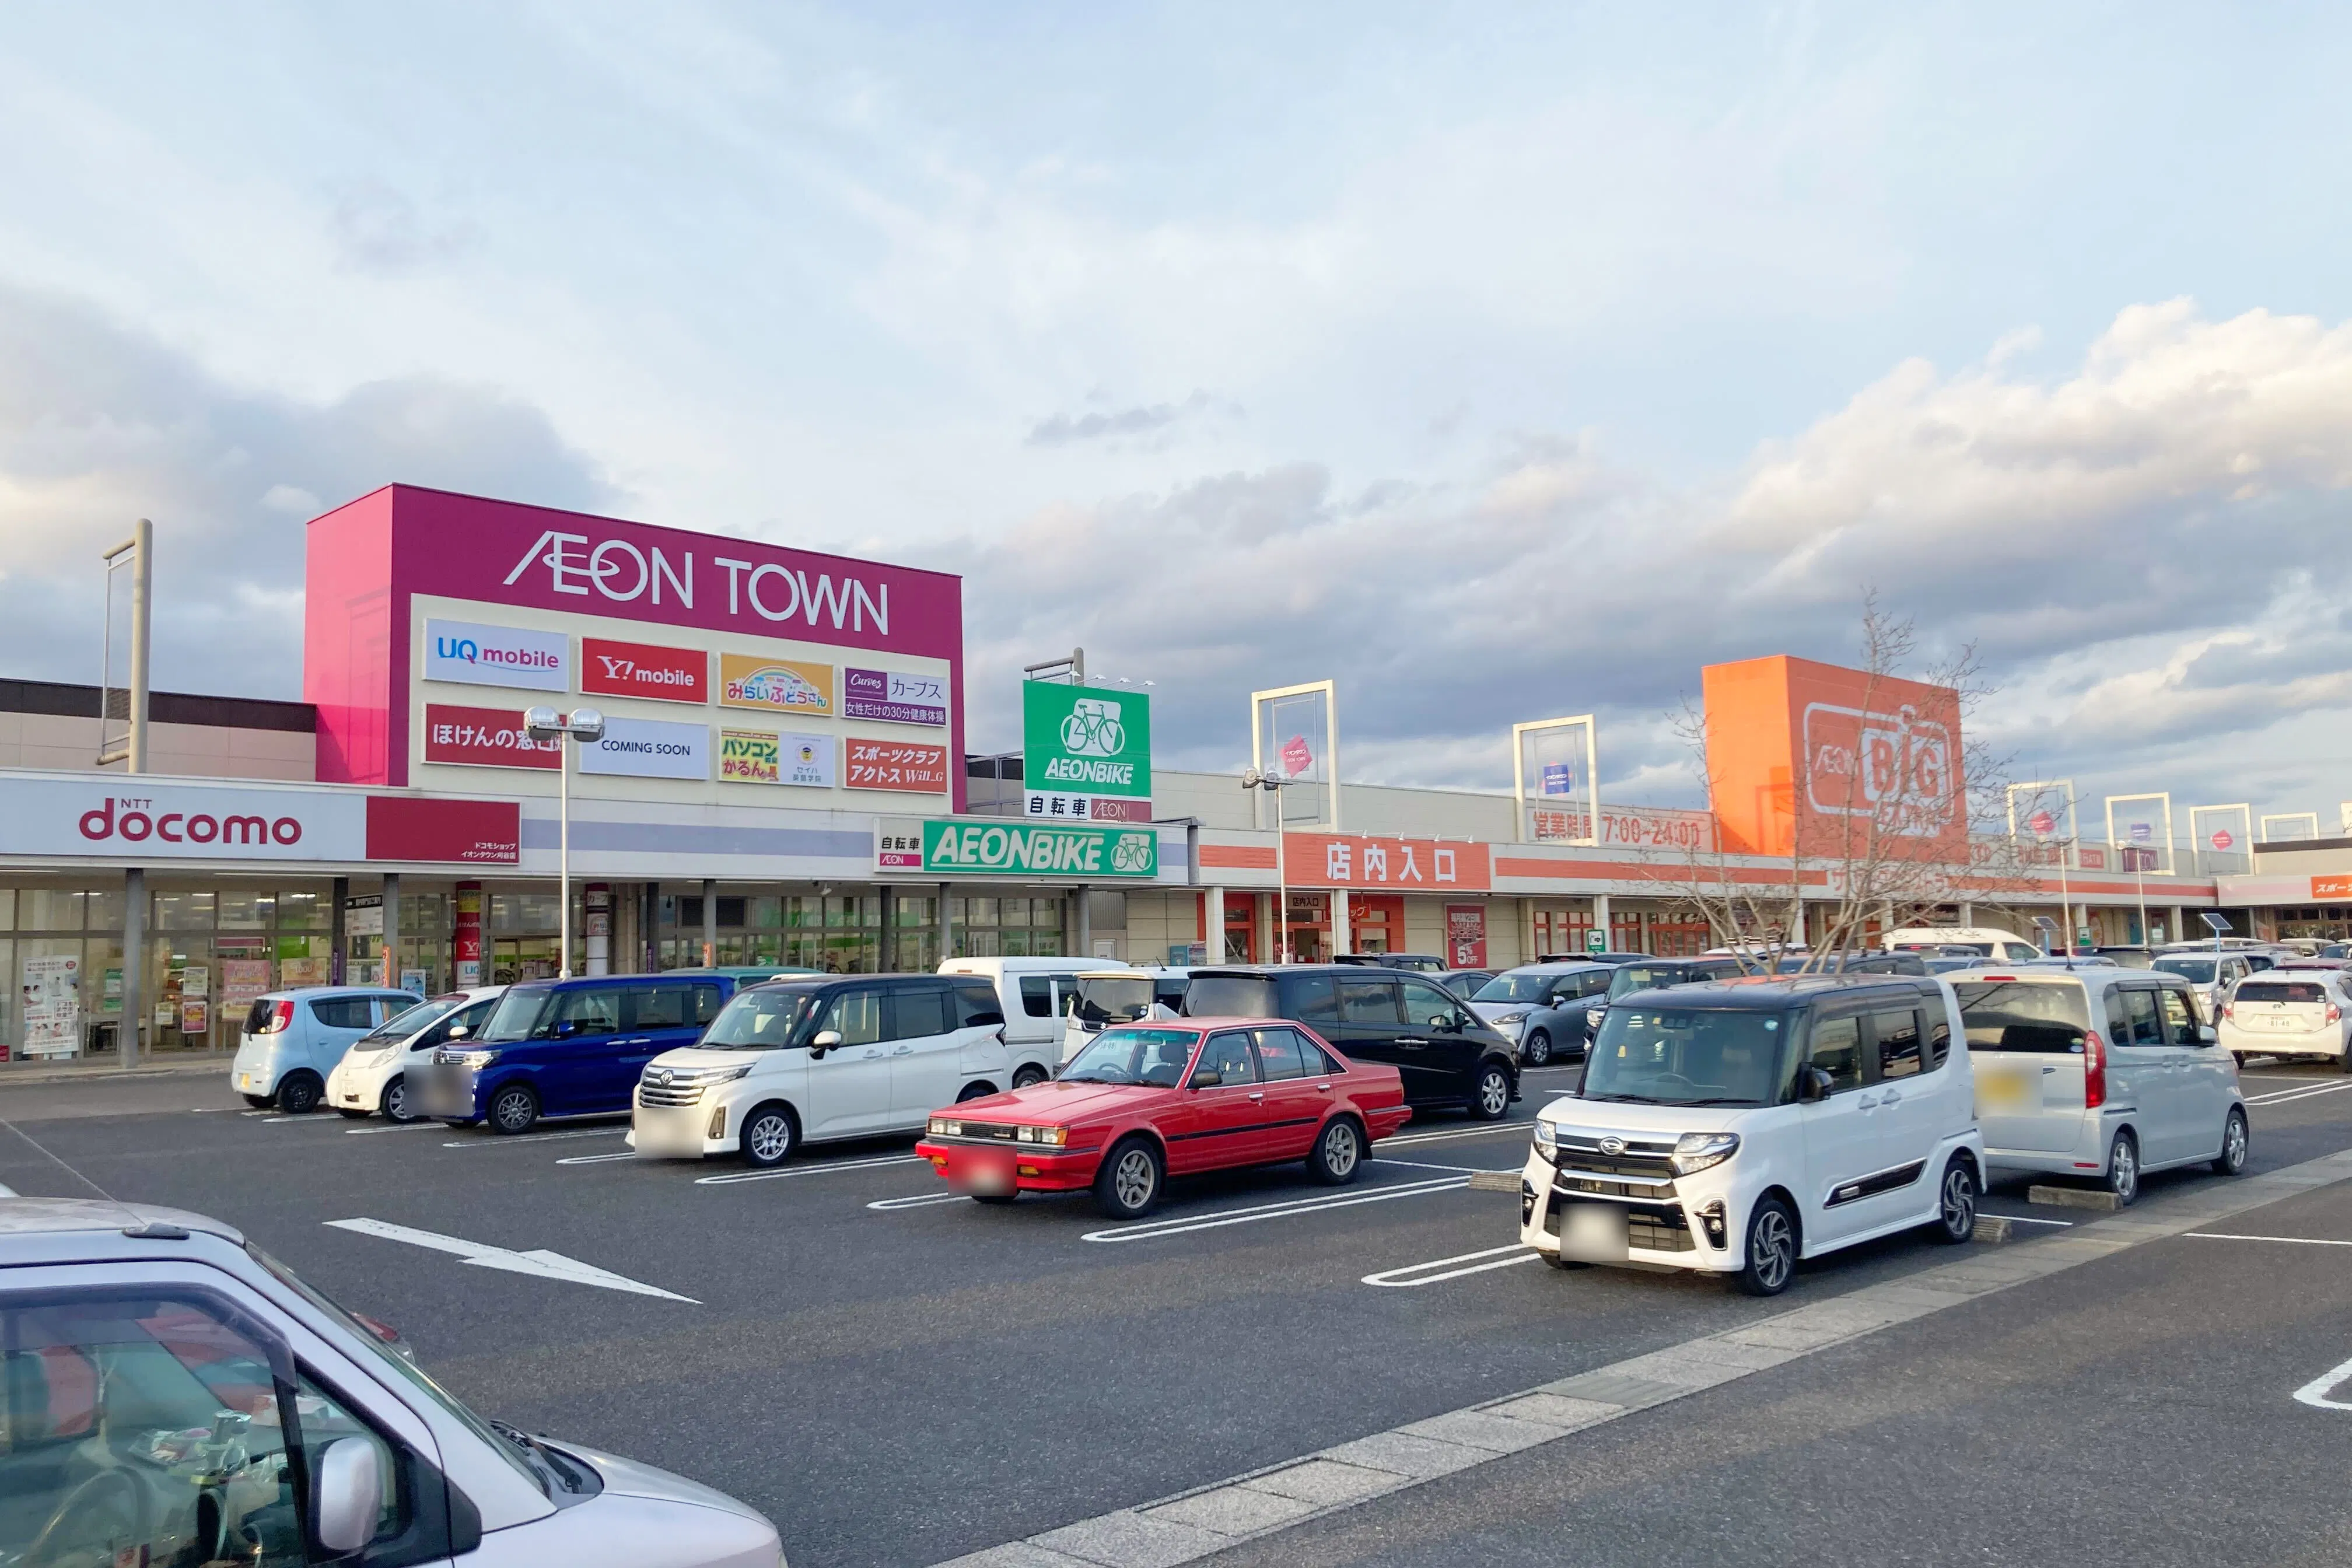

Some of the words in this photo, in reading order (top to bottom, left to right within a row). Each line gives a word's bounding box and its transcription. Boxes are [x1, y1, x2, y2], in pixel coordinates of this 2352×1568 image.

[715, 557, 889, 635] TOWN
[438, 638, 477, 664] UQ
[483, 648, 558, 668] mobile
[850, 674, 881, 689] Curves
[891, 679, 942, 699] カーブス
[727, 681, 827, 708] みらいふどうさん
[846, 702, 944, 723] 女性だけの30分健康体操
[601, 740, 652, 753] COMING
[656, 744, 690, 755] SOON
[723, 738, 777, 757] パソコン
[852, 746, 941, 765] スポーツクラブ
[850, 765, 901, 783] アクトス
[1044, 758, 1134, 785] AEONBIKE
[121, 799, 152, 809] NTT
[1030, 796, 1086, 816] 自転車
[79, 797, 302, 845] docomo
[475, 842, 516, 850] ドコモショップ
[881, 836, 920, 851] 自転車
[930, 825, 1105, 871] AEONBIKE
[461, 851, 516, 859] イオンタウン刈谷店
[1326, 842, 1456, 883] 店内入口
[1293, 897, 1319, 907] 店内入口
